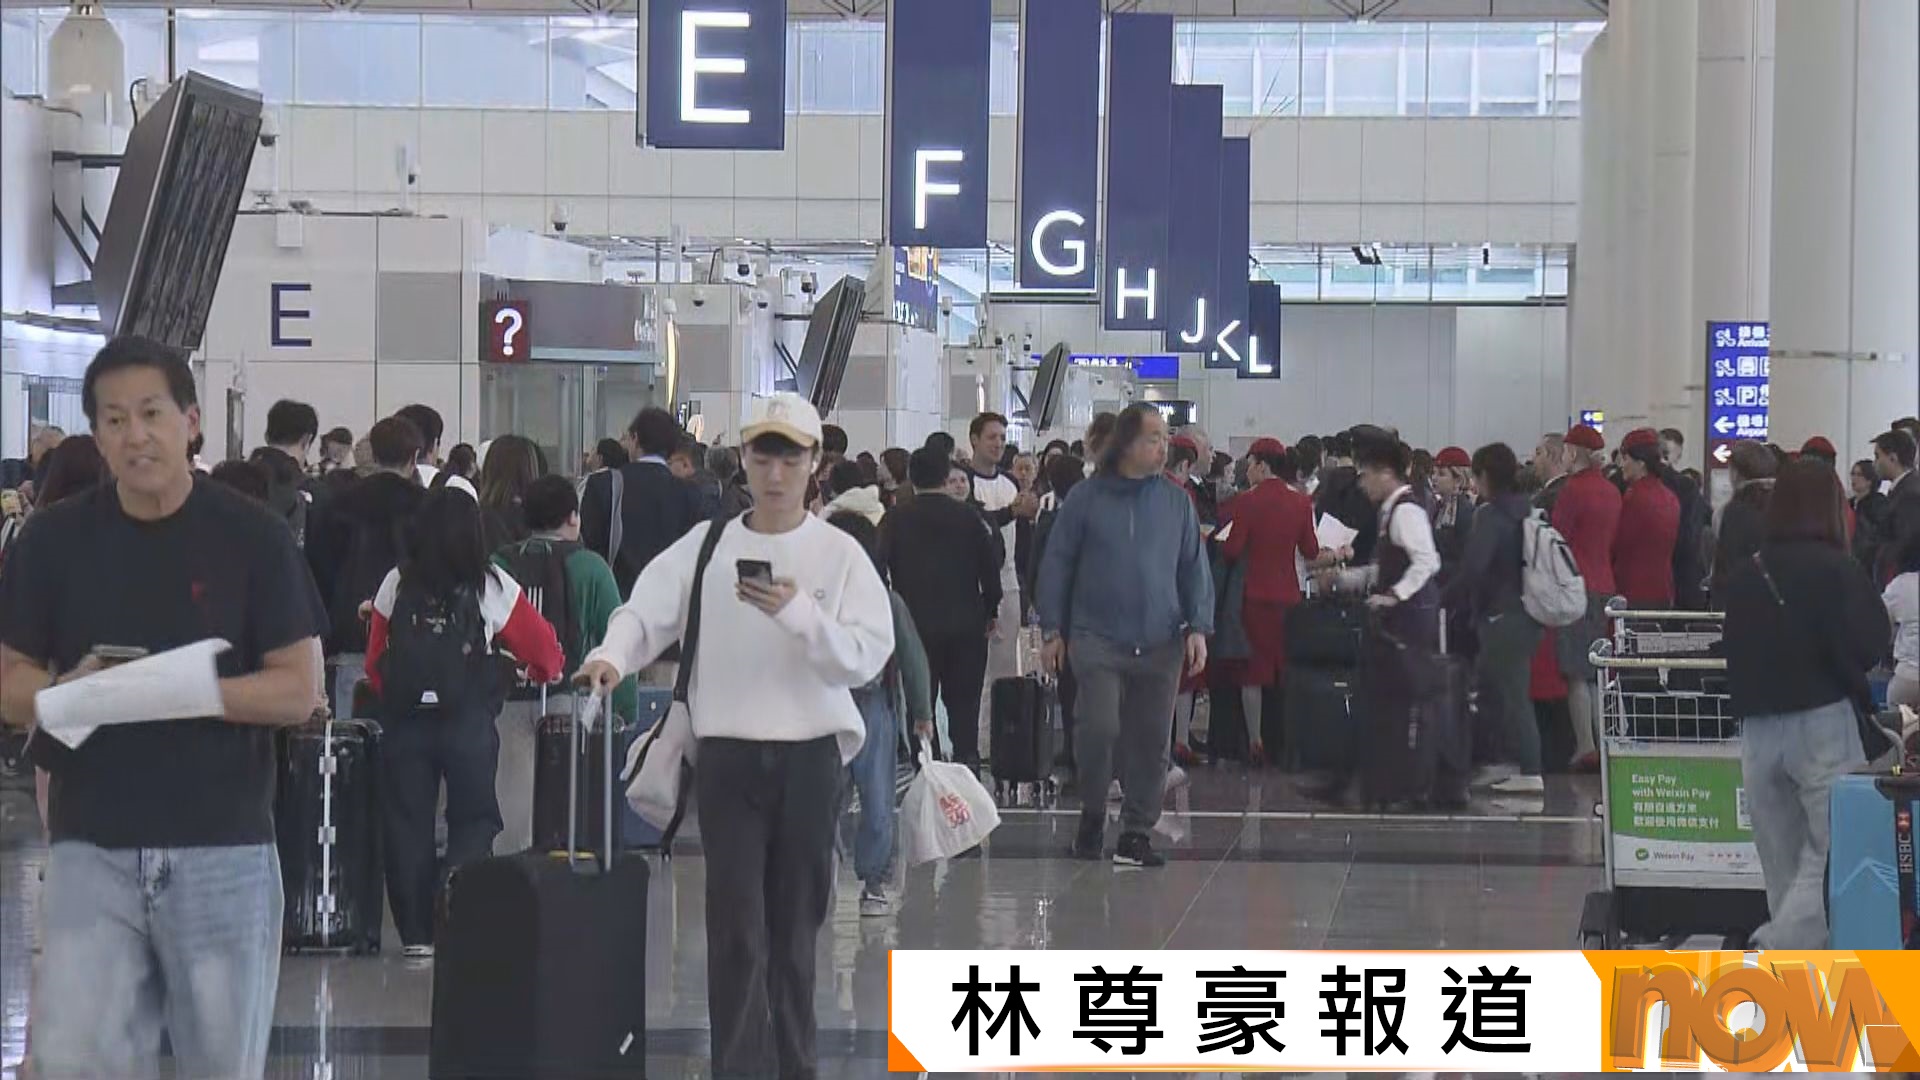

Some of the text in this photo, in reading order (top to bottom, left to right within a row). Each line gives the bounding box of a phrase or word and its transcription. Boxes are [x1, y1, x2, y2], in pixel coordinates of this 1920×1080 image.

[680, 11, 750, 123] E
[914, 149, 964, 229] F
[1031, 209, 1086, 275] G
[271, 283, 312, 347] E
[1116, 267, 1155, 320] H
[1180, 297, 1207, 345] J
[1249, 335, 1273, 374] L
[1632, 774, 1676, 786] Easy Pay
[1632, 787, 1711, 800] with Weixin Pay
[1899, 832, 1913, 873] HSBC
